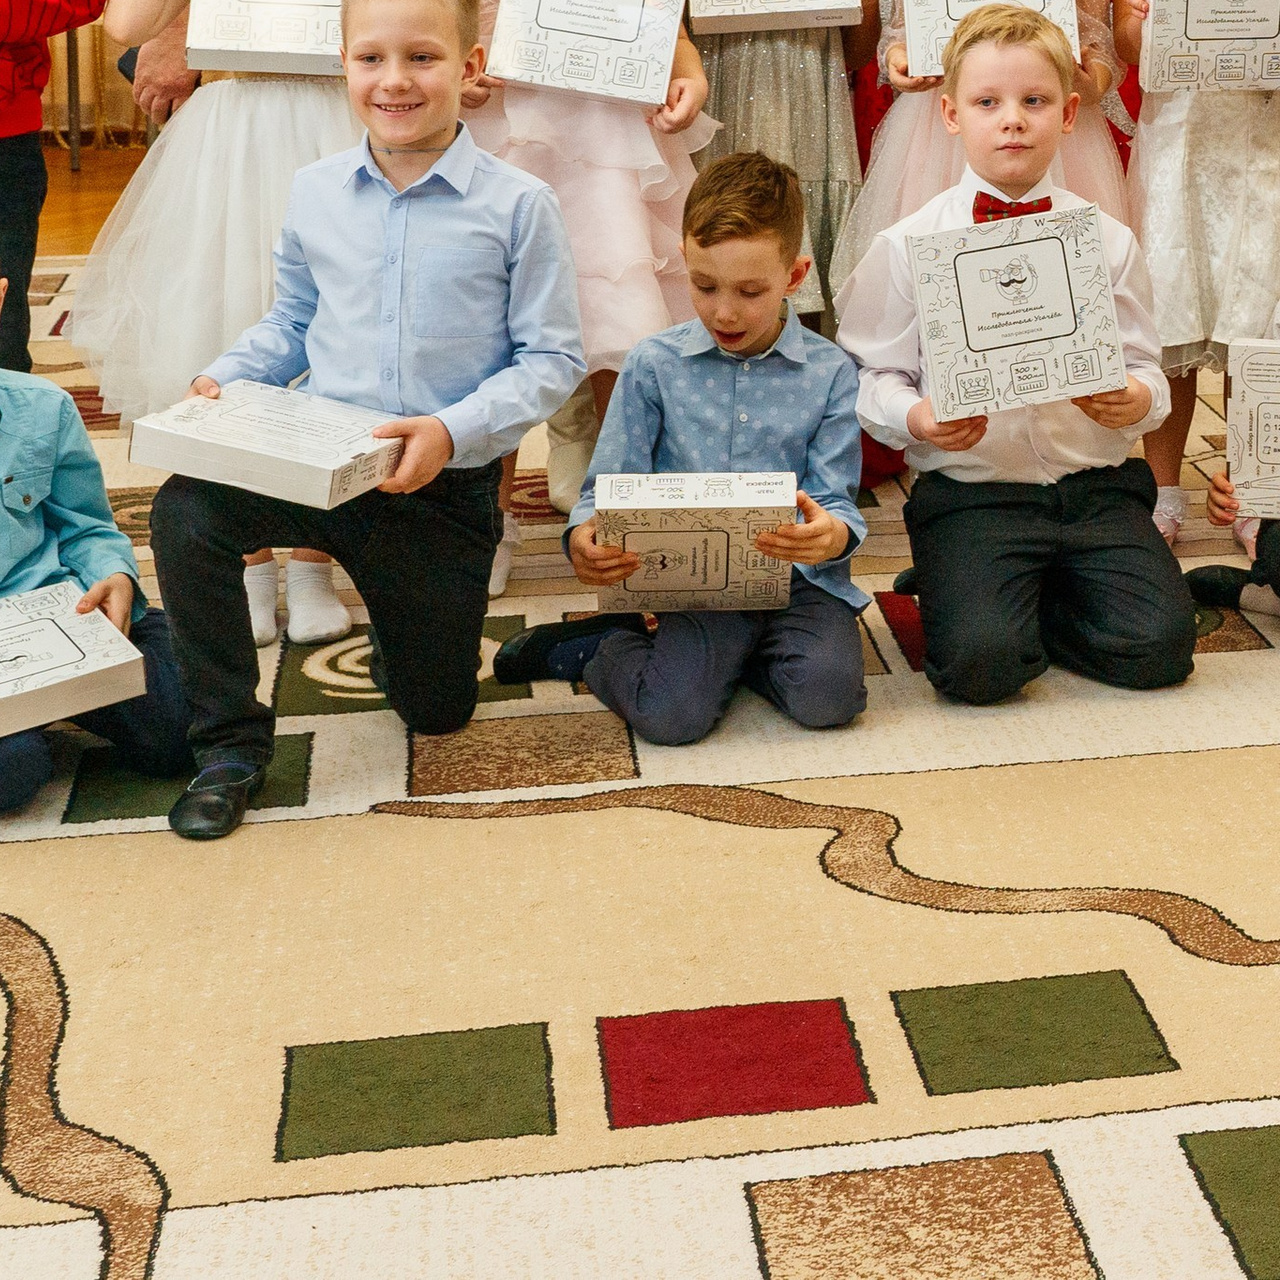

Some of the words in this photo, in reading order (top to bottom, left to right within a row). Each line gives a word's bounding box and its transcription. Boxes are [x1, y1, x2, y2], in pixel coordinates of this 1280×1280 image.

[1034, 218, 1046, 226] W
[1075, 250, 1081, 258] S
[991, 304, 1045, 319] Приключения
[977, 317, 1034, 332] Исследователя
[1015, 366, 1030, 374] 300
[1074, 364, 1087, 373] 12
